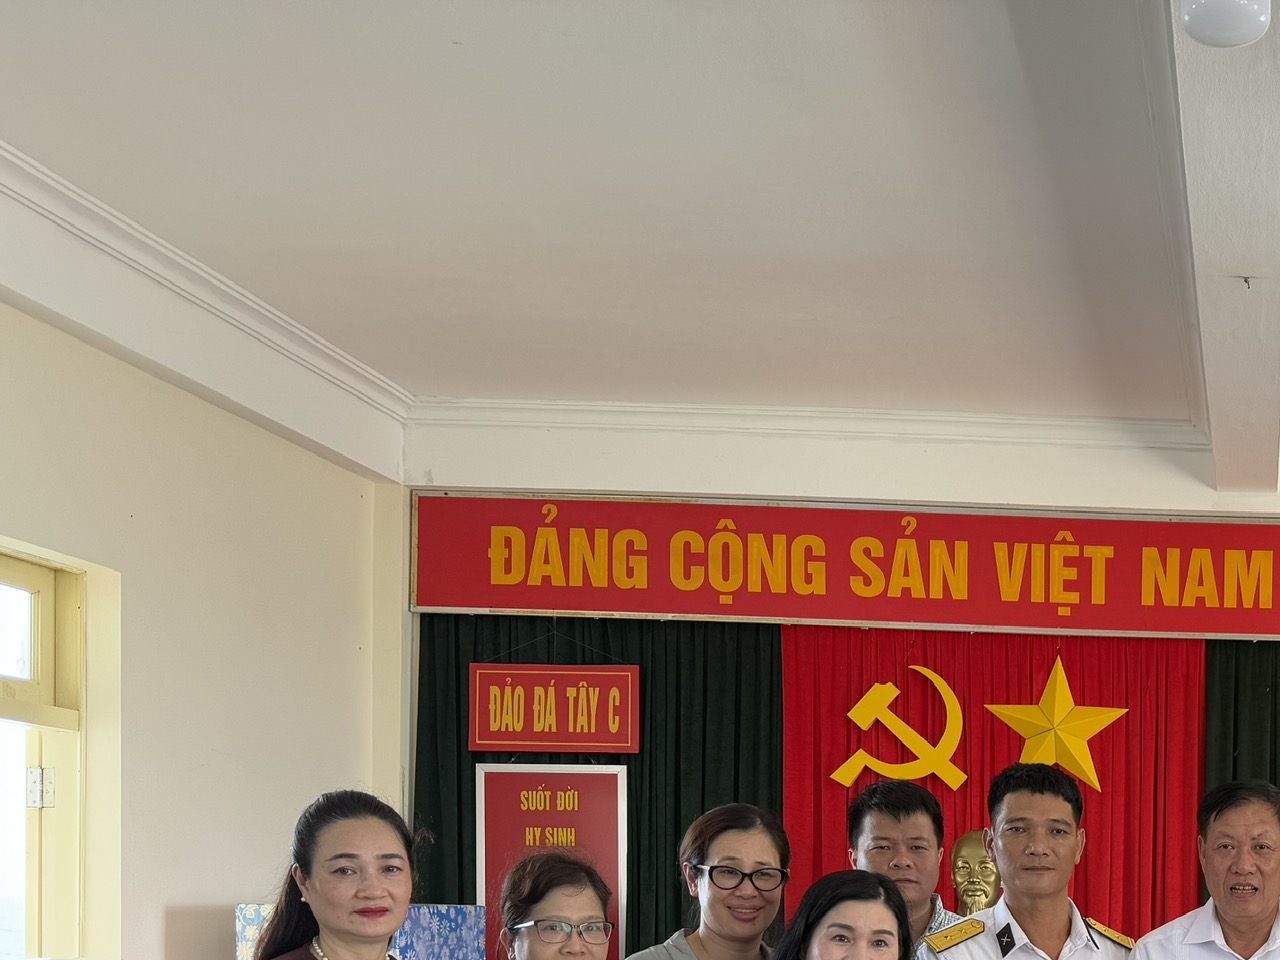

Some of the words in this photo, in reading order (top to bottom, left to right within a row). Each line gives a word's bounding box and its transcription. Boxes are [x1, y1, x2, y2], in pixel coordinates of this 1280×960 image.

[488, 503, 649, 589] ĐẢNG
[668, 517, 827, 605] CỘNG
[849, 515, 970, 601] SẢN
[993, 530, 1114, 617] VIỆT
[1141, 547, 1274, 610] NAM
[489, 677, 525, 732] ĐẢO
[532, 679, 557, 733] ĐÁ
[566, 681, 600, 733] TÂY
[608, 687, 621, 734] C
[520, 783, 552, 812] SUỐT
[557, 785, 579, 812] ĐỜI
[525, 827, 541, 847] HY
[545, 827, 576, 847] SINH
